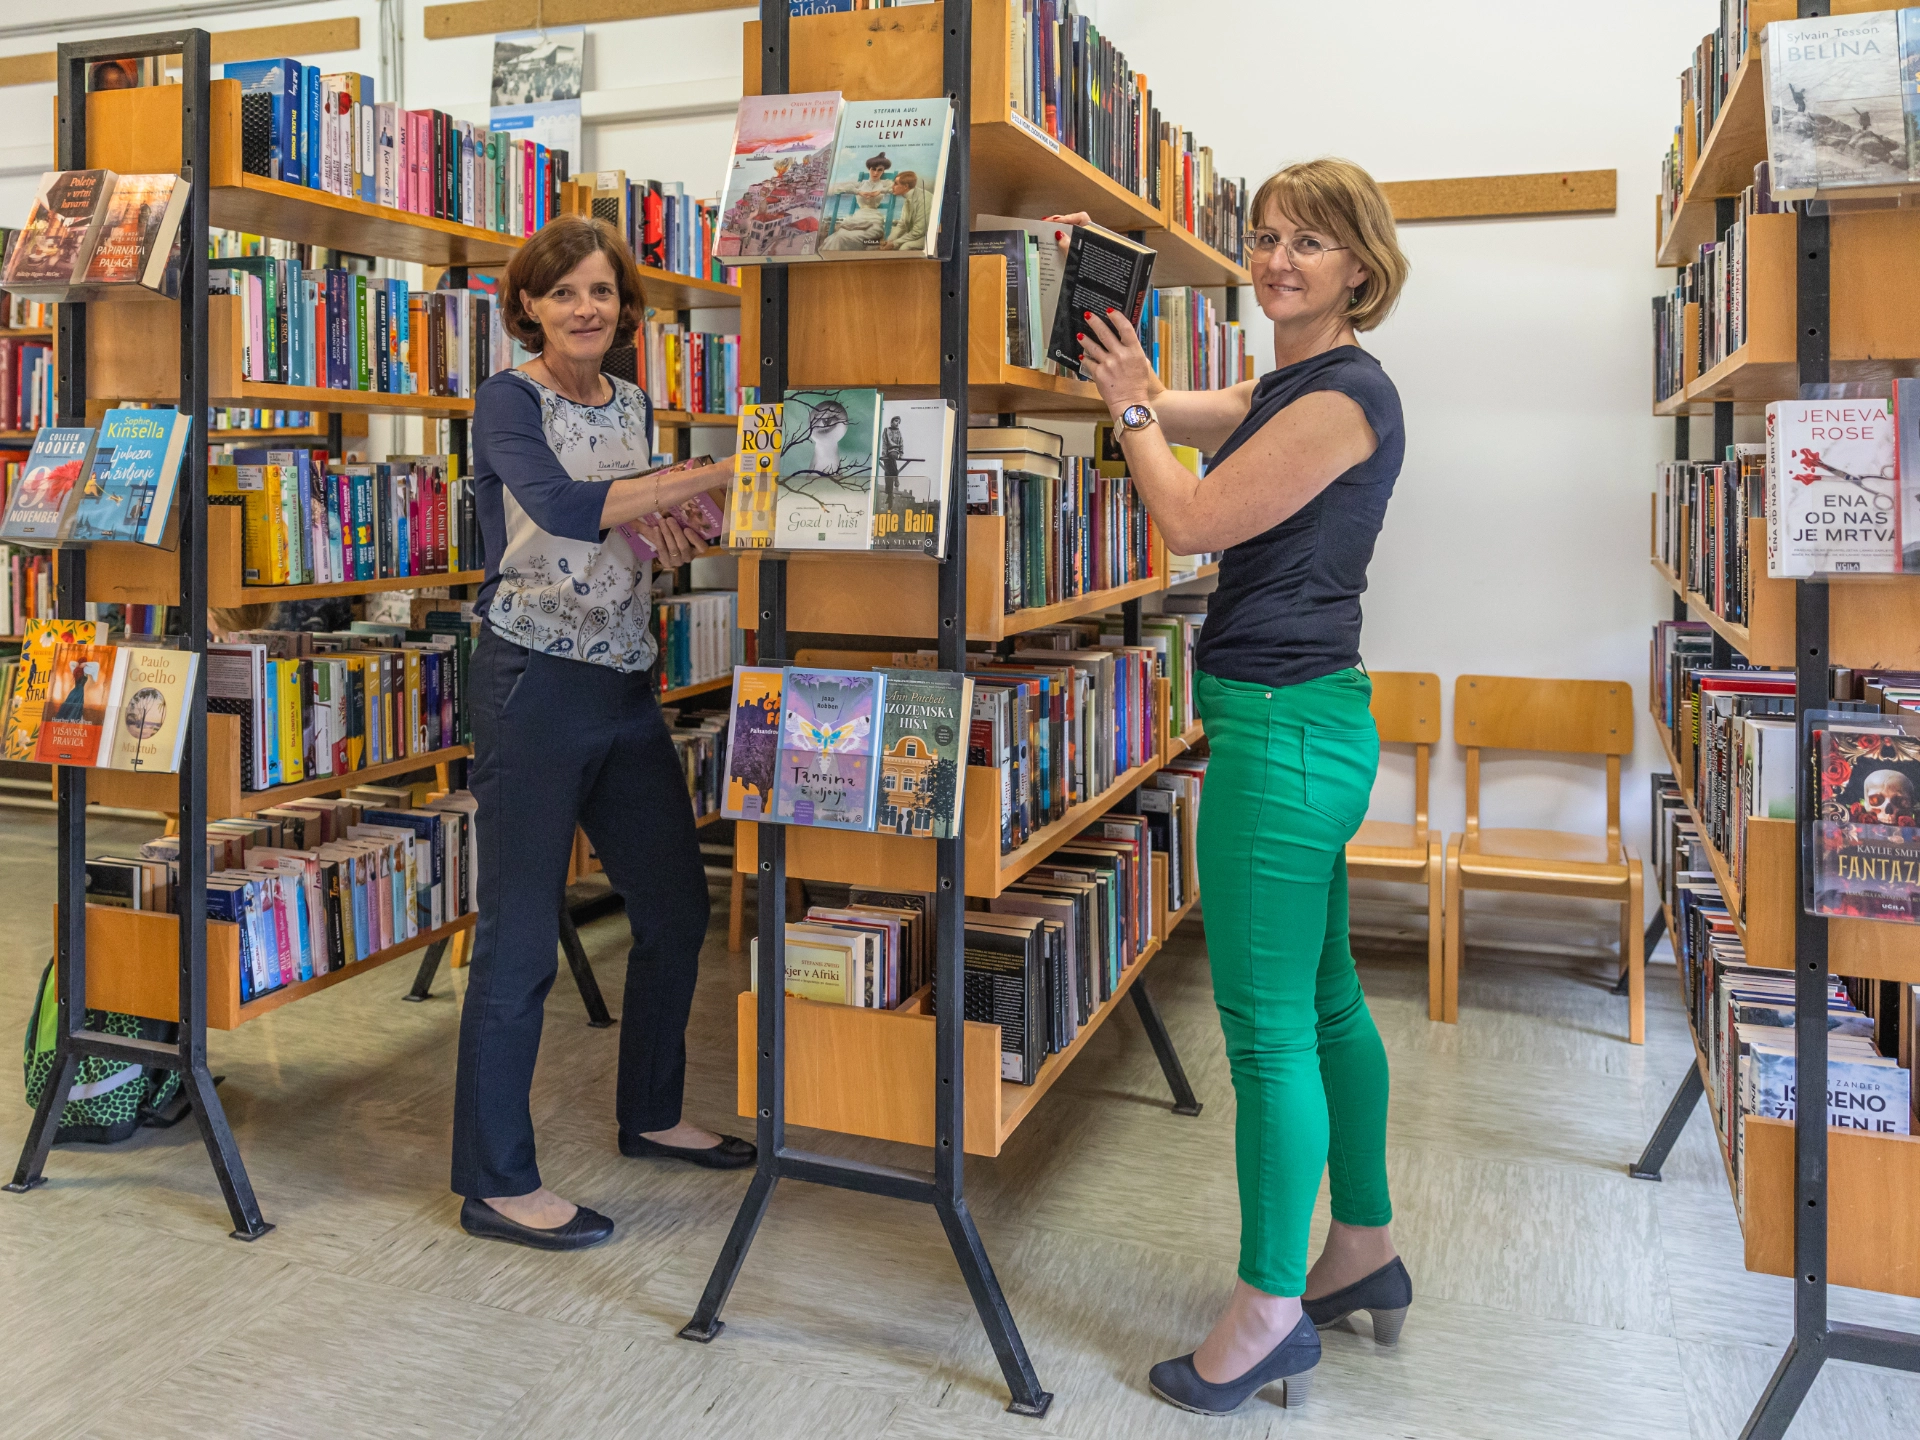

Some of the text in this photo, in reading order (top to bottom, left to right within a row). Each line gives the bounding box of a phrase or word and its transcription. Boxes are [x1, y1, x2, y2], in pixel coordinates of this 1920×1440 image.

[1787, 32, 1829, 44] Sylvain
[1788, 40, 1881, 62] BELINA
[855, 117, 932, 130] SICILIJANSKI
[878, 130, 905, 140] LEVI
[69, 175, 97, 188] Poletje
[72, 188, 92, 198] vrtni
[61, 198, 91, 209] kavarni
[96, 245, 145, 256] PAPIRNATA
[98, 255, 133, 268] PALAČA
[124, 416, 151, 426] Sophie
[1798, 409, 1887, 423] JENEVA
[107, 422, 165, 439] Kinsella
[1812, 427, 1875, 440] ROSE
[36, 442, 86, 454] HOOVER
[110, 445, 153, 464] Ljubezen
[100, 462, 156, 487] in življenje
[1771, 468, 1776, 480] JE
[18, 465, 52, 509] 9.
[437, 501, 446, 512] O
[1824, 495, 1868, 508] ENA
[9, 510, 60, 524] NOVEMBER
[700, 504, 720, 529] KASTEN
[787, 512, 859, 532] Gozd v hiši
[904, 510, 934, 533] Bain
[1772, 510, 1778, 526] OD
[1805, 511, 1888, 525] OD NAS
[1793, 529, 1895, 542] JE MRTVA
[141, 656, 170, 668] Paulo
[129, 669, 176, 685] Coelho
[763, 698, 781, 711] GA
[887, 691, 946, 705] Ann Patchett
[290, 702, 295, 710] ZA
[817, 702, 838, 710] Robben
[885, 703, 954, 719] IZOZEMSKA
[899, 715, 928, 730] HIŠA
[52, 725, 88, 738] VIŠAVSKA
[750, 728, 778, 736] Palisandrov
[52, 736, 84, 748] PRAVICA
[121, 742, 157, 755] Maktub
[790, 766, 856, 788] Tančina
[1857, 845, 1920, 858] KAYLIE SMIT
[1838, 854, 1920, 886] FANTAZ
[1882, 903, 1905, 911] UČILA
[804, 970, 810, 978] v
[812, 969, 840, 981] Afriki
[1836, 1080, 1881, 1091] ZANDER
[1784, 1084, 1886, 1113] ISRENO
